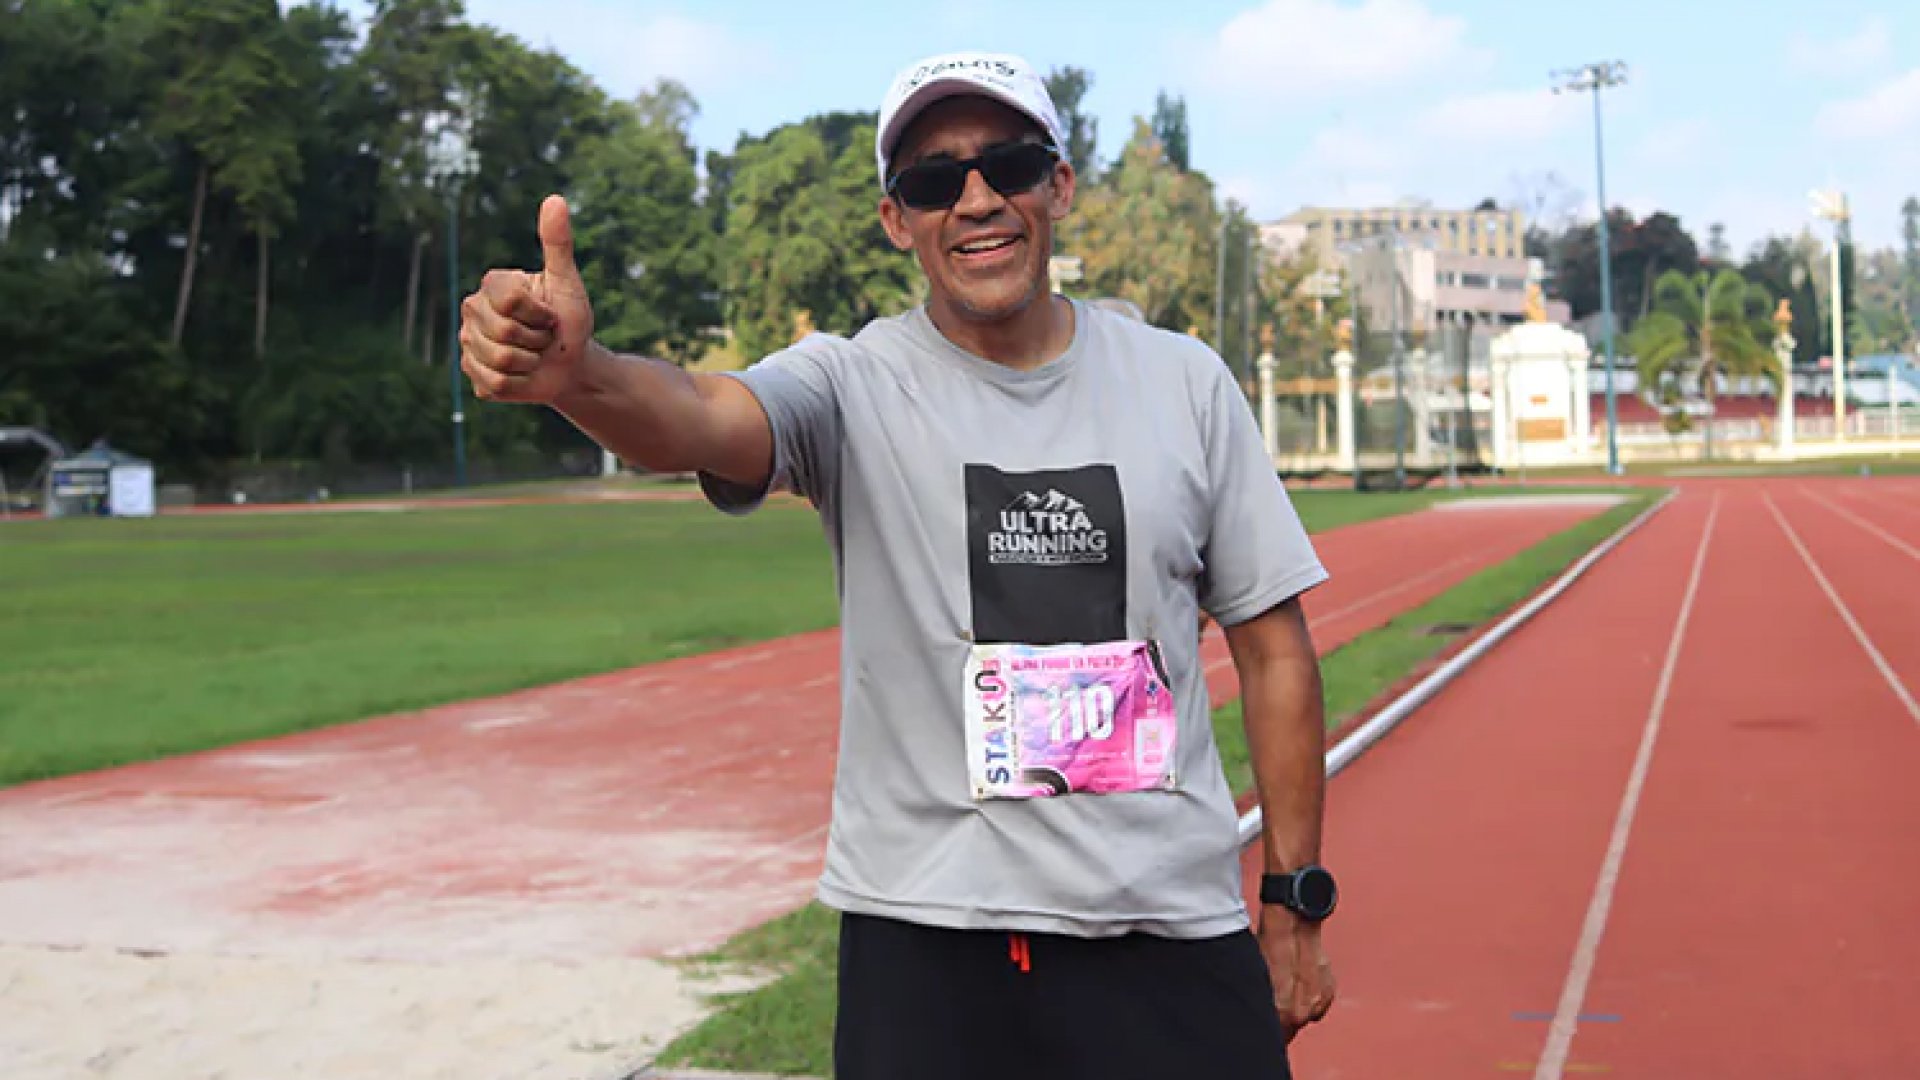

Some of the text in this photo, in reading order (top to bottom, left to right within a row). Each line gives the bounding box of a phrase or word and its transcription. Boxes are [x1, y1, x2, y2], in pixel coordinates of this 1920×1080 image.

[1000, 511, 1092, 533] ULTRA
[988, 530, 1107, 554] RUNNING
[1047, 682, 1115, 741] 110
